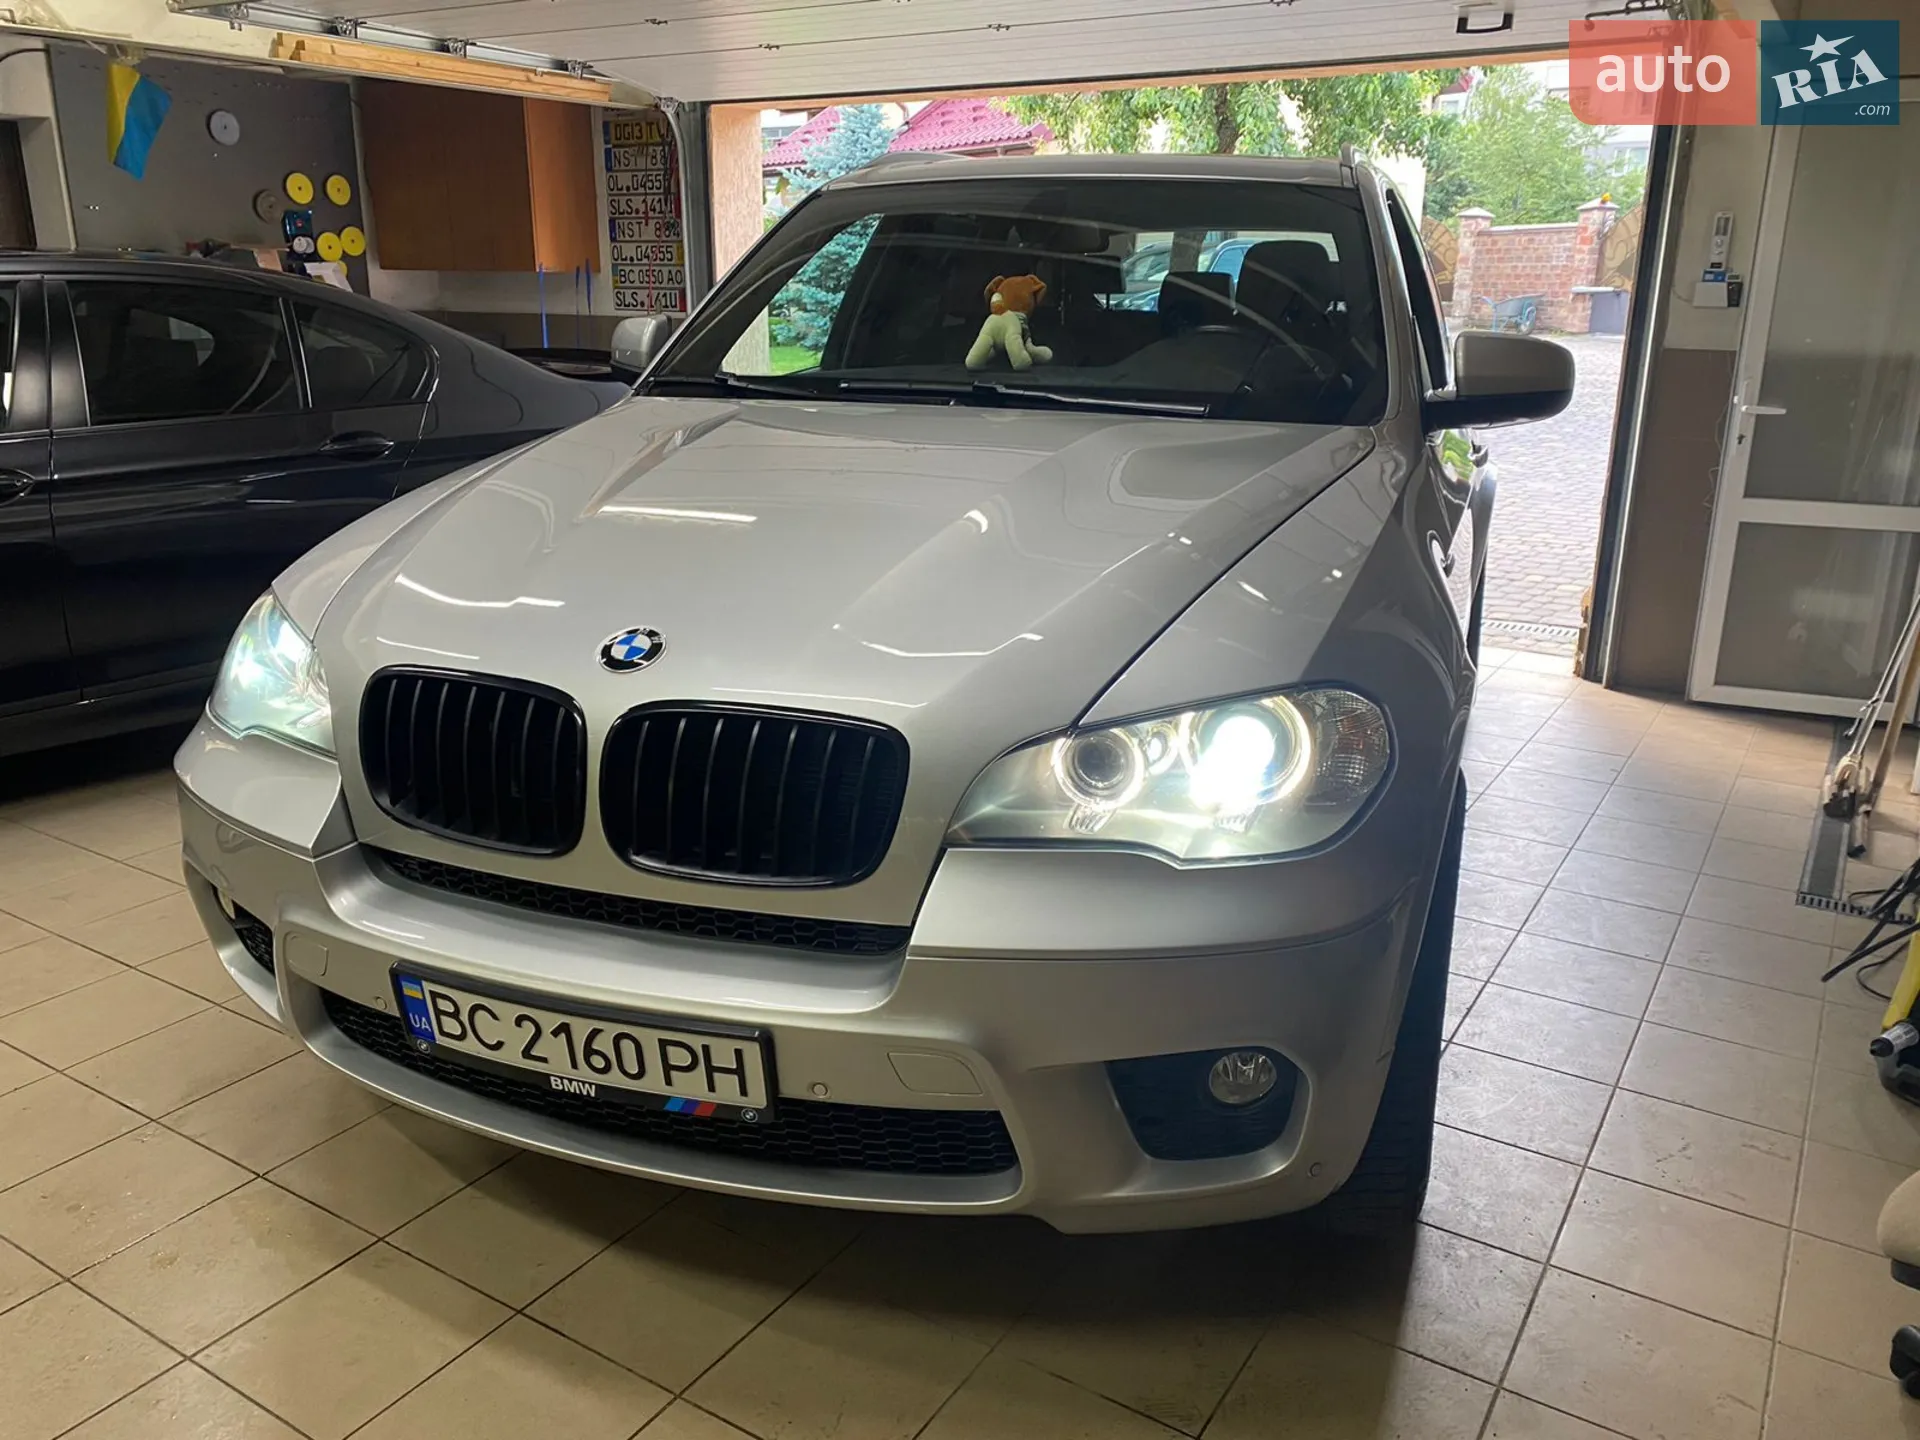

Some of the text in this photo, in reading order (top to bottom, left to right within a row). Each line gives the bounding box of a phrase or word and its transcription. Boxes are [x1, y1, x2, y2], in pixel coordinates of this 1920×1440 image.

[617, 221, 643, 239] NST
[619, 269, 636, 284] BC
[409, 1011, 432, 1032] UA
[428, 989, 748, 1098] BC 2160 PH
[549, 1075, 596, 1098] BMW
